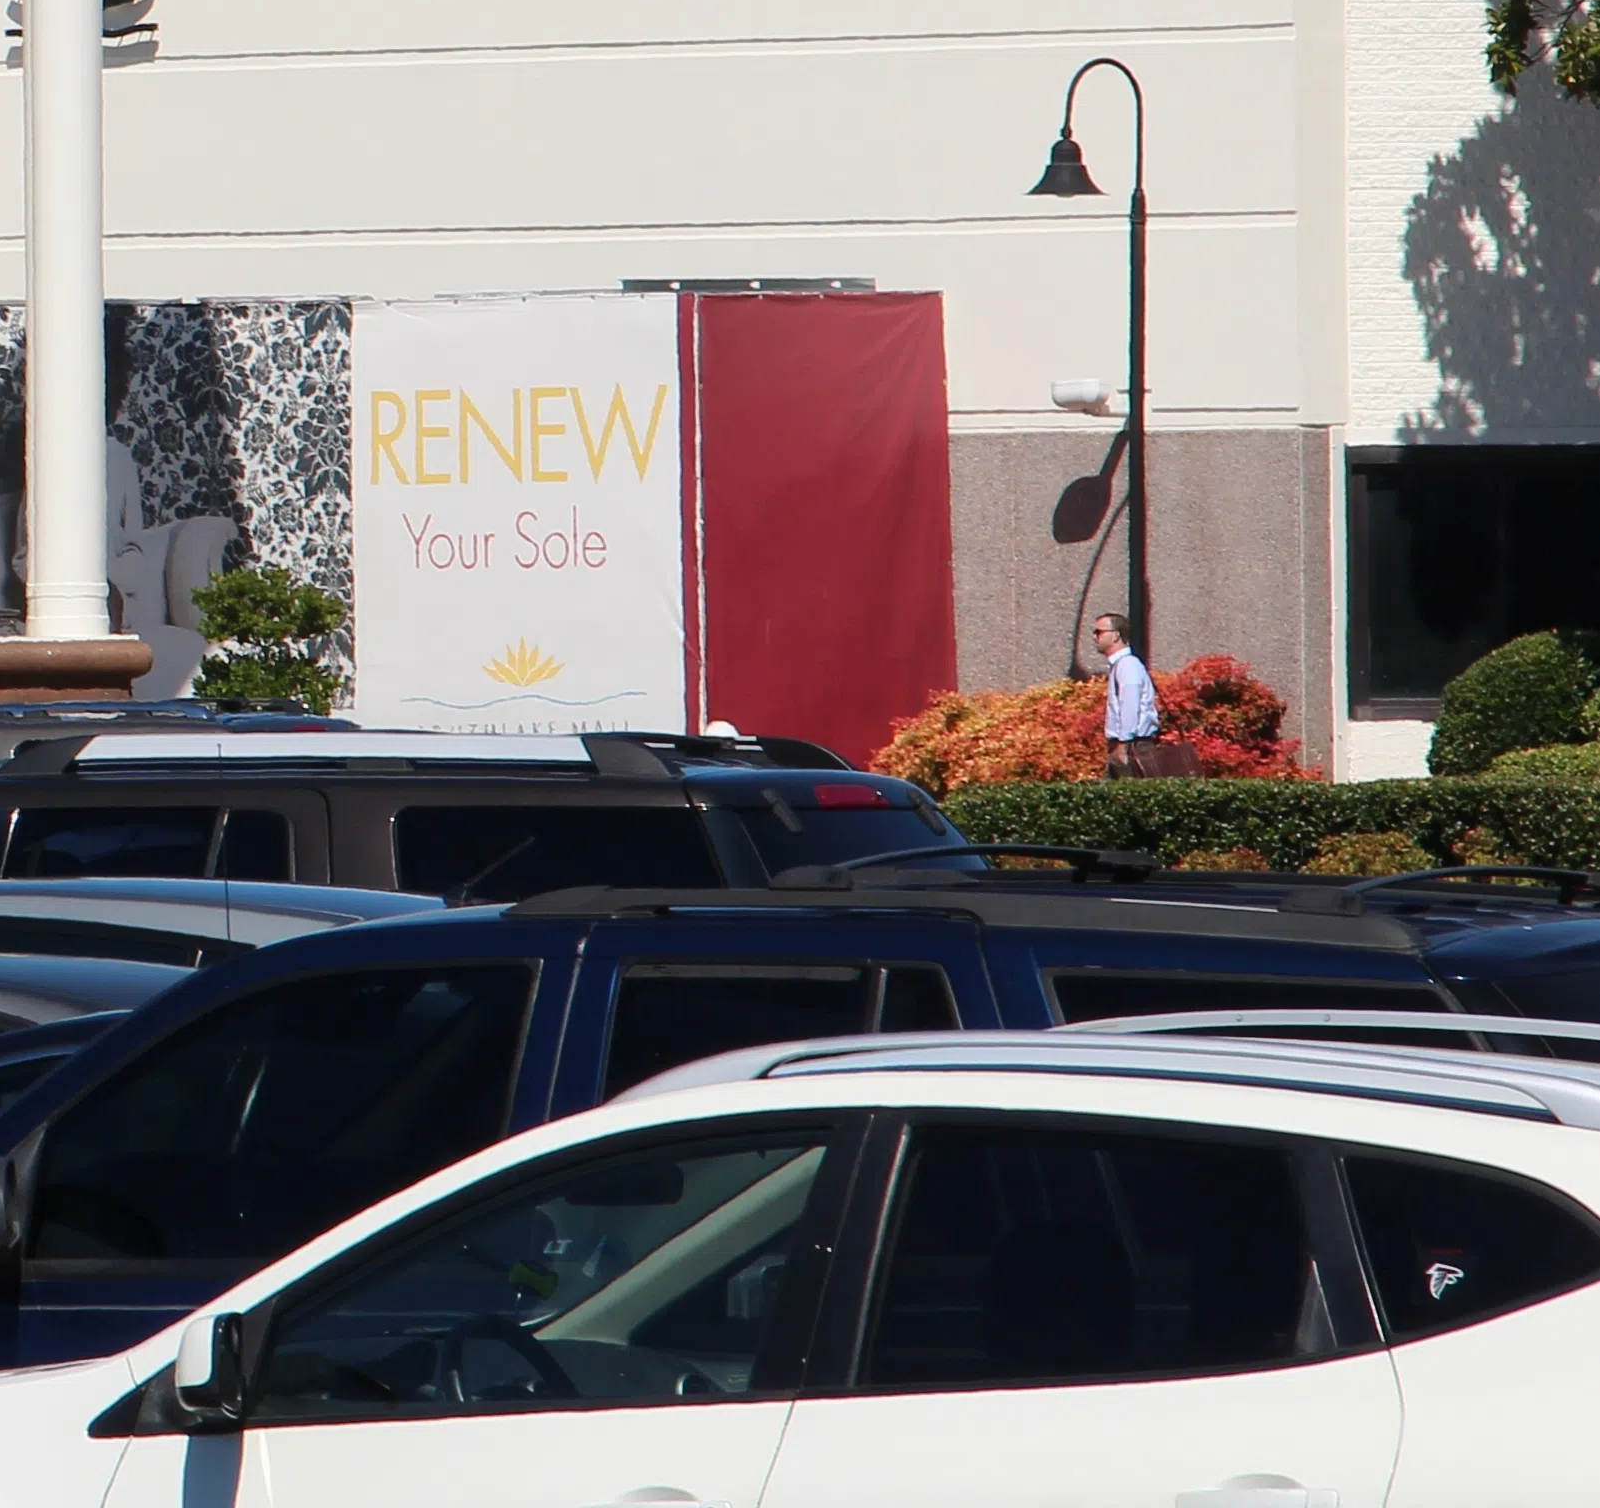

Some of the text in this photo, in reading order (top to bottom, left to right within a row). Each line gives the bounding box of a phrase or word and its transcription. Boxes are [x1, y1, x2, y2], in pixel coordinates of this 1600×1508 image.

[370, 384, 668, 486] RENEW
[402, 506, 609, 571] Your Sole
